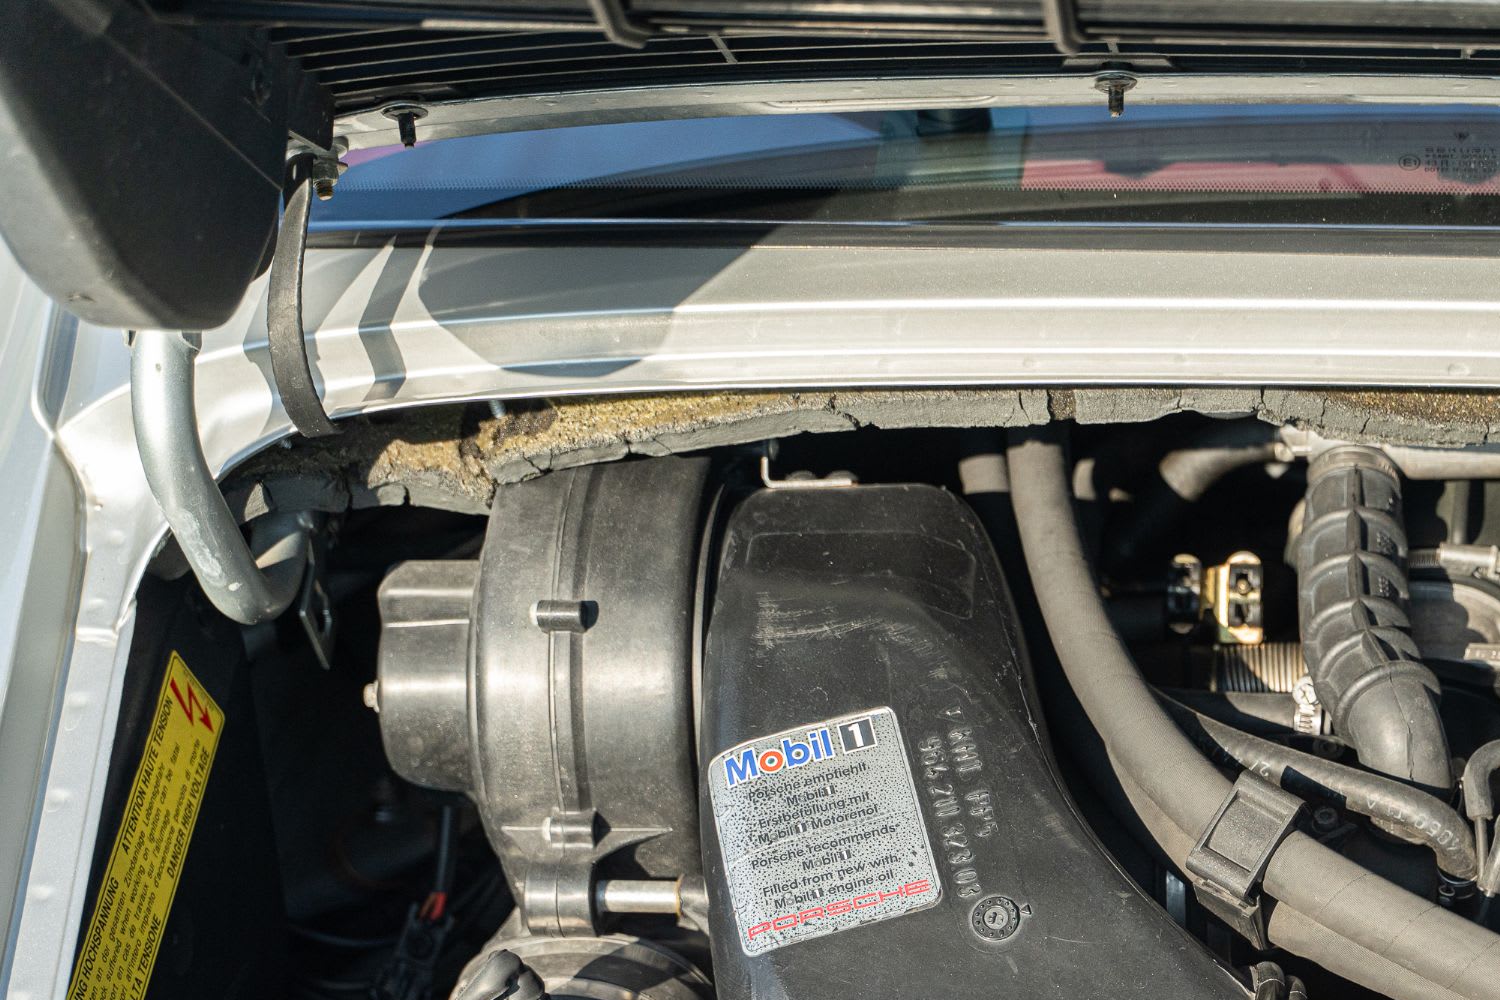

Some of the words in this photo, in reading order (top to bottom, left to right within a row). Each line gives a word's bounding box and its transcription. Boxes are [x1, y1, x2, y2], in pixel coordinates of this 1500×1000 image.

[121, 784, 146, 855] ATTENTION
[142, 743, 158, 789] HAUTE
[153, 693, 173, 748] TENSION
[725, 729, 834, 787] Mobil
[166, 825, 186, 880] DANGER
[180, 796, 194, 832] HIGH
[189, 744, 210, 801] VOLTAGE
[748, 778, 801, 802] Porsche
[758, 796, 845, 830] Erstbefüllung
[848, 791, 870, 804] mit
[786, 788, 821, 805] Mobil
[105, 937, 122, 983] suffered
[119, 905, 131, 937] when
[129, 862, 145, 906] working
[142, 844, 149, 861] on
[147, 805, 162, 846] ignition
[158, 782, 168, 806] can
[165, 764, 172, 783] be
[169, 739, 180, 766] fatal
[751, 846, 806, 869] Porsche
[808, 822, 895, 854] recommends
[757, 826, 793, 844] Mobil
[802, 853, 838, 871] Mobil
[95, 964, 103, 983] an
[101, 942, 110, 965] der
[108, 890, 127, 942] gesamten
[123, 826, 145, 888] Zündanlage
[142, 759, 165, 828] Lebensgefahr
[116, 963, 124, 982] en
[122, 939, 131, 963] cas
[128, 921, 136, 940] de
[134, 881, 149, 922] travaux
[147, 860, 155, 880] sur
[152, 806, 171, 860] l'allumage
[124, 935, 141, 982] all'intero
[139, 889, 156, 936] impianto
[153, 823, 175, 889] d'accensione
[184, 766, 191, 782] di
[762, 879, 798, 897] Filled
[802, 870, 833, 886] from
[837, 862, 865, 877] new
[869, 853, 898, 869] with
[774, 890, 810, 909] Mobil
[827, 874, 874, 896] engine
[877, 869, 894, 882] oil
[82, 874, 118, 980] HOCHSPANNUNG
[748, 879, 931, 941] PORSCHE
[137, 911, 161, 978] TENSIONE
